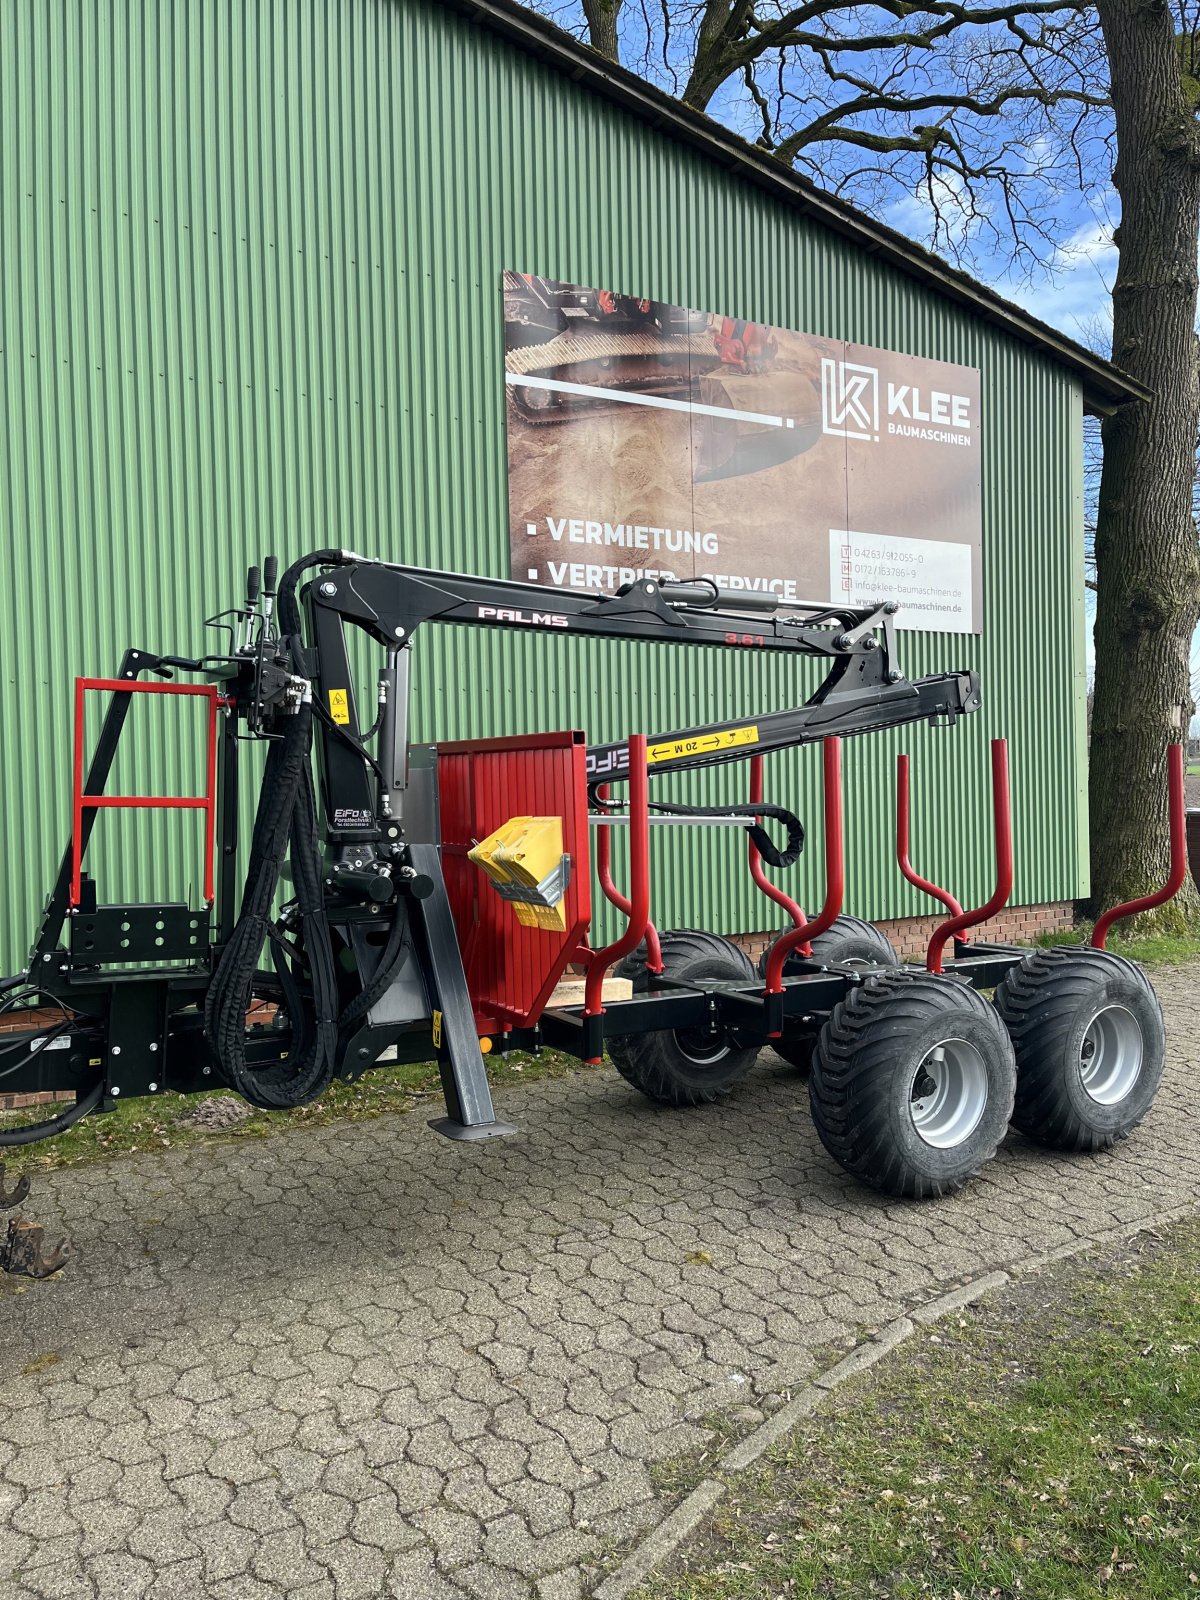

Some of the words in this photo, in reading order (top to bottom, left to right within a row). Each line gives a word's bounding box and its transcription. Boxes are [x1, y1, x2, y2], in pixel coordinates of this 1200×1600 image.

[887, 382, 971, 429] KLEE
[887, 423, 971, 446] BAUMASCHINEN
[546, 517, 718, 555] VERMIETUNG
[855, 581, 962, 598] info@klee-baumaschinen.de
[855, 597, 962, 613] www.kbaumaschinen.de
[478, 606, 569, 627] PALMS
[724, 632, 764, 648] 3.61
[674, 744, 683, 753] M
[686, 742, 698, 751] 20
[334, 809, 360, 818] EiFo
